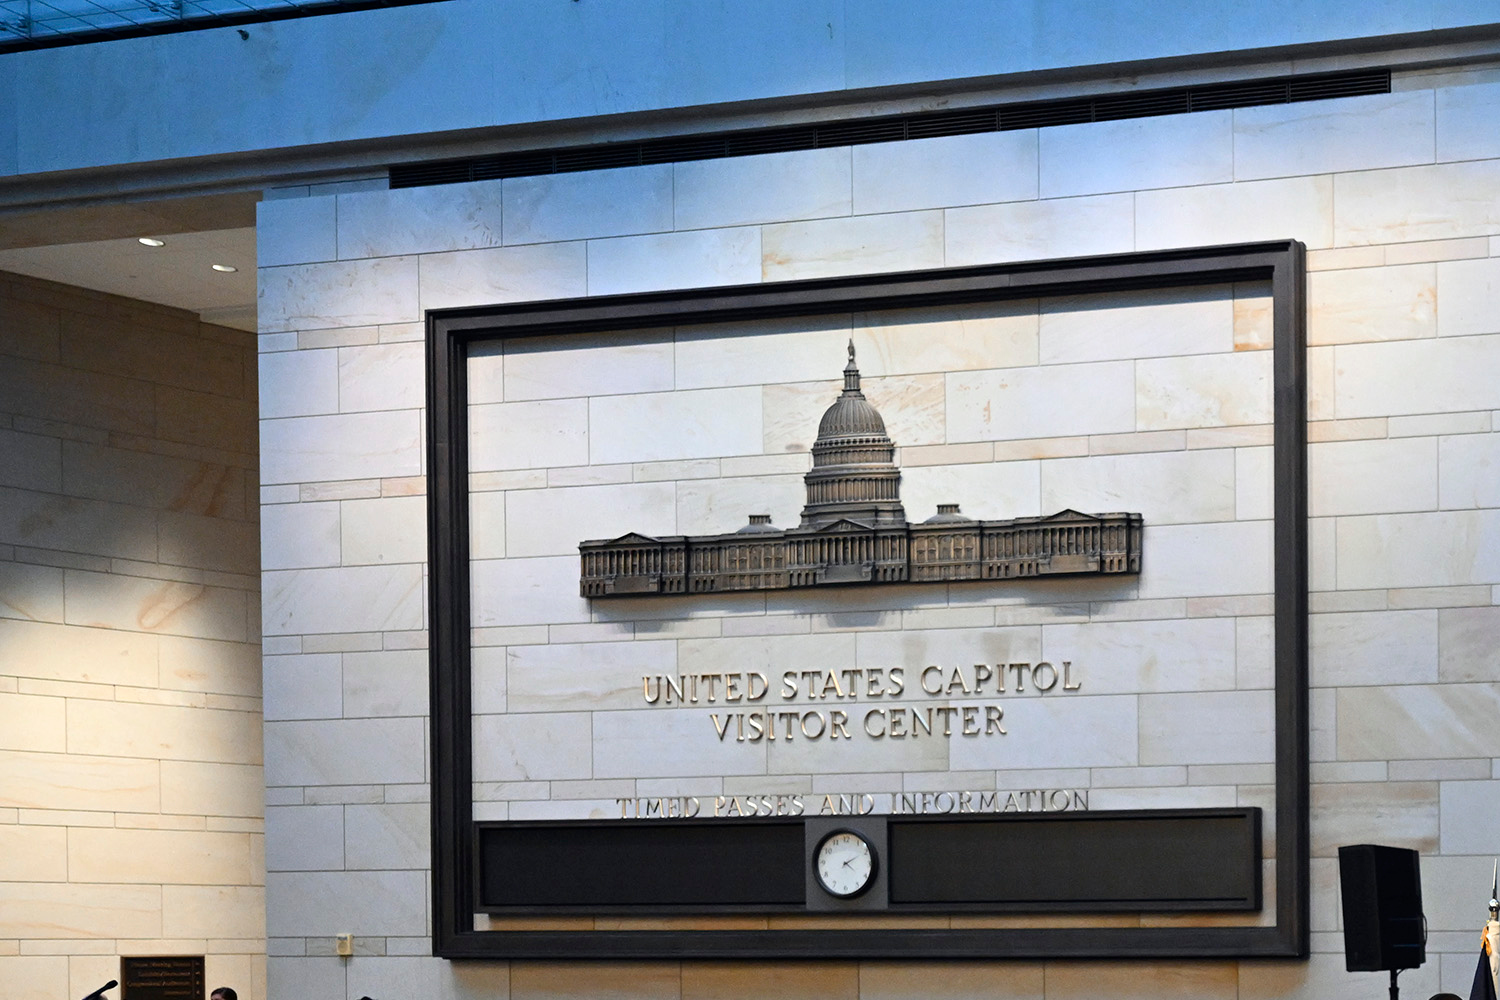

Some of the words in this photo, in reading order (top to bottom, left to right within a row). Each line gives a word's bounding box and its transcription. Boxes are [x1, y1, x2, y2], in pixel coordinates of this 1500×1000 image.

[642, 672, 768, 704] UNITED
[781, 668, 904, 699] STATES
[921, 661, 1082, 695] CAPITOL
[710, 711, 852, 741] VISITOR
[864, 705, 1007, 738] CENTER
[616, 796, 700, 819] TIMED
[714, 795, 804, 818] PASSES
[819, 793, 874, 816] AND
[891, 789, 1090, 815] INFORMATION
